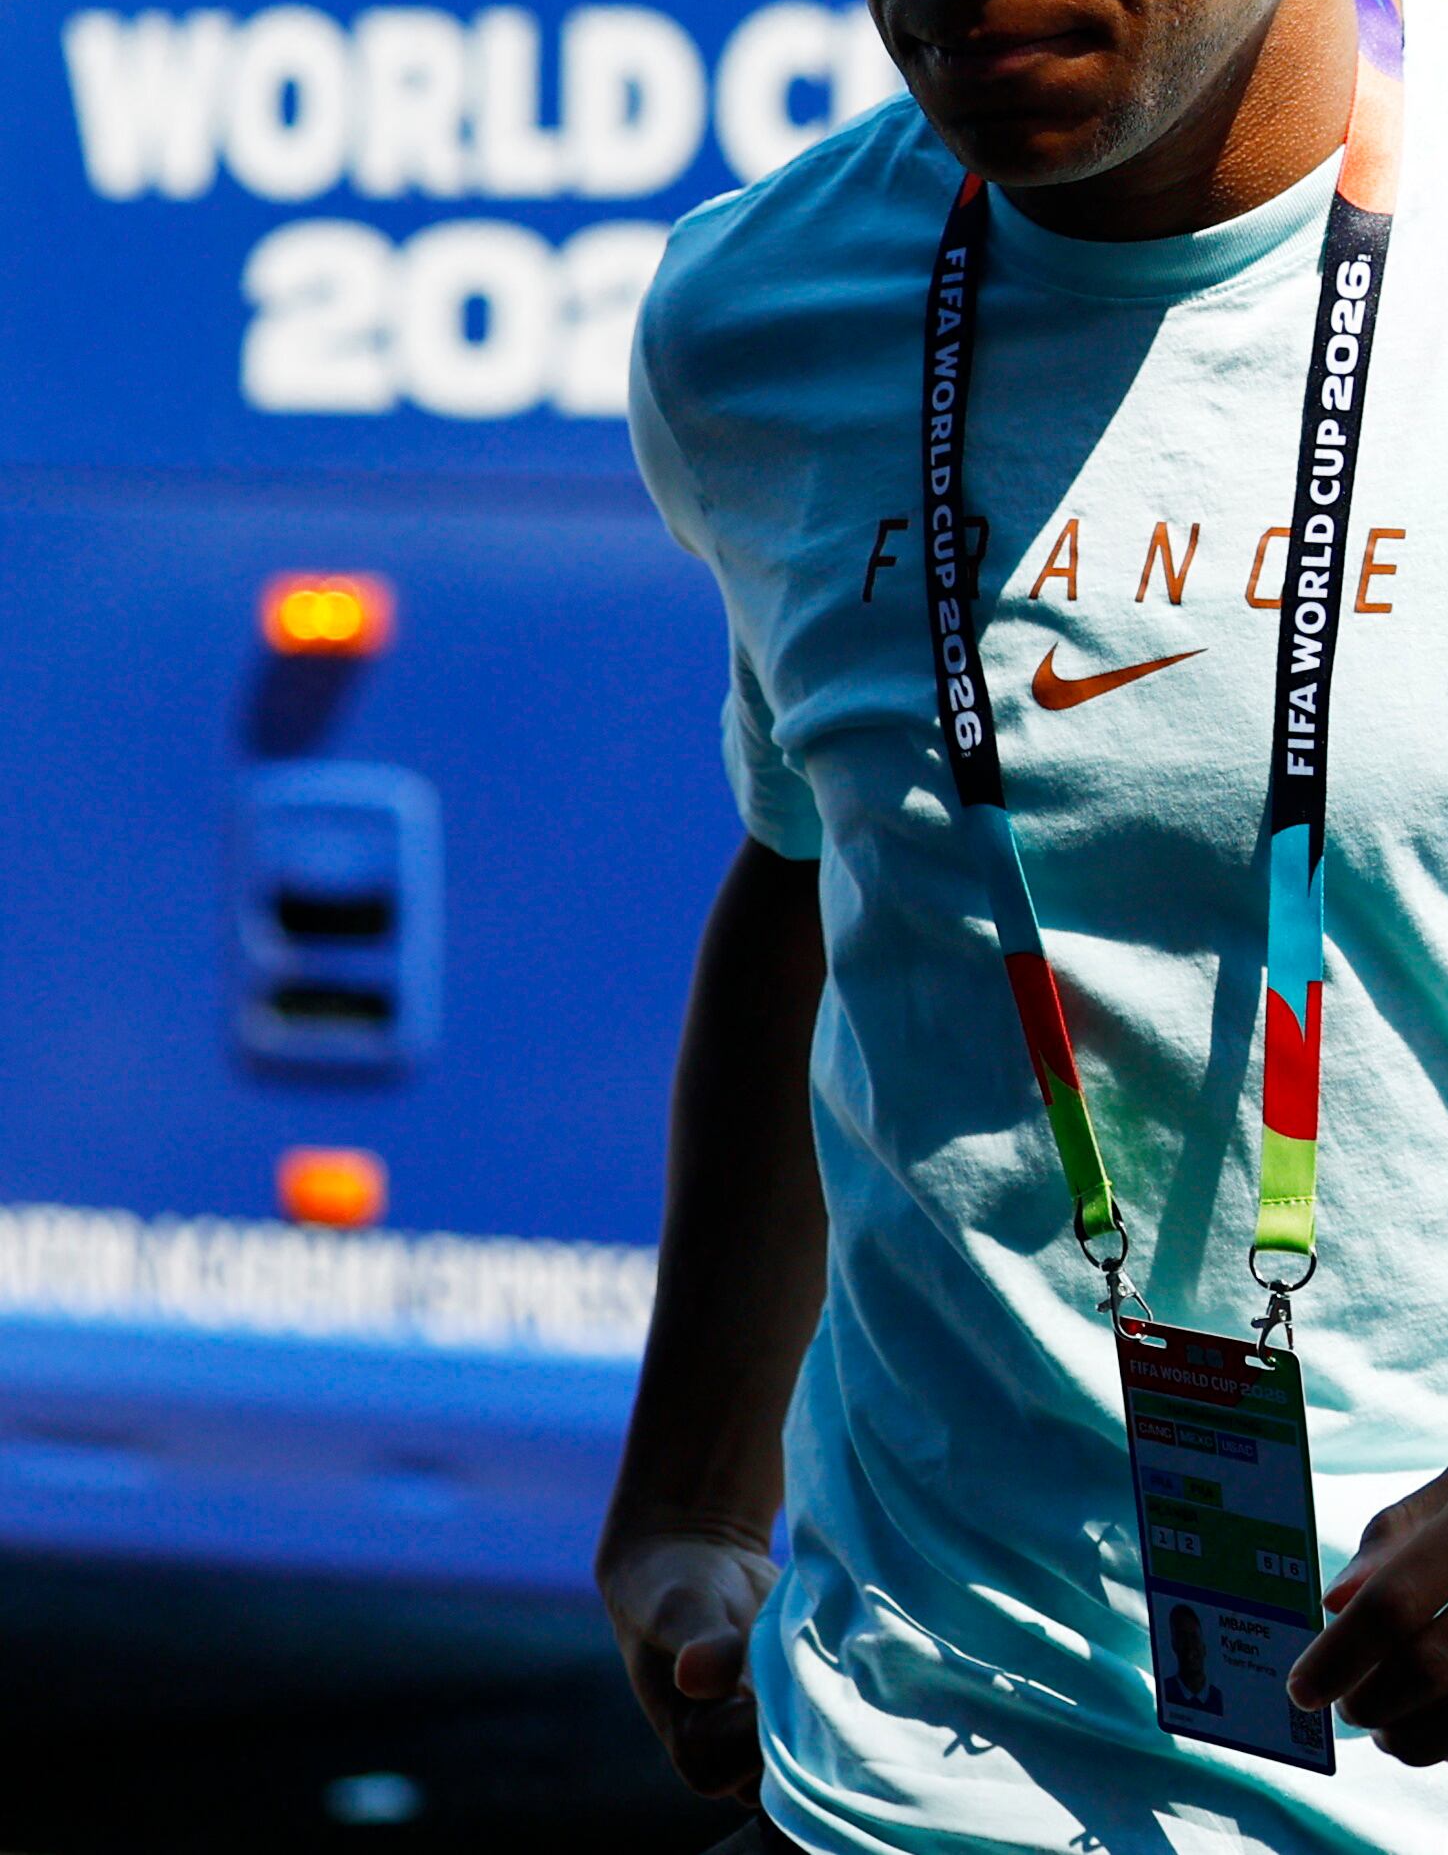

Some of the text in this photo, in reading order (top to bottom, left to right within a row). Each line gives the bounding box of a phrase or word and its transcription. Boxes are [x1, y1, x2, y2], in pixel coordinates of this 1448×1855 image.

[62, 2, 706, 200] WORLD
[242, 218, 668, 420] 202
[931, 247, 982, 750] FIFA WORLD CUP 2026
[1310, 418, 1347, 506] CUP
[1291, 514, 1335, 674] WORLD
[1287, 682, 1318, 776] FIFA
[1130, 1359, 1158, 1378] FIFA
[1160, 1365, 1209, 1389] WORLD
[1211, 1376, 1238, 1394] CUP
[1218, 1614, 1271, 1640] MBAPPE
